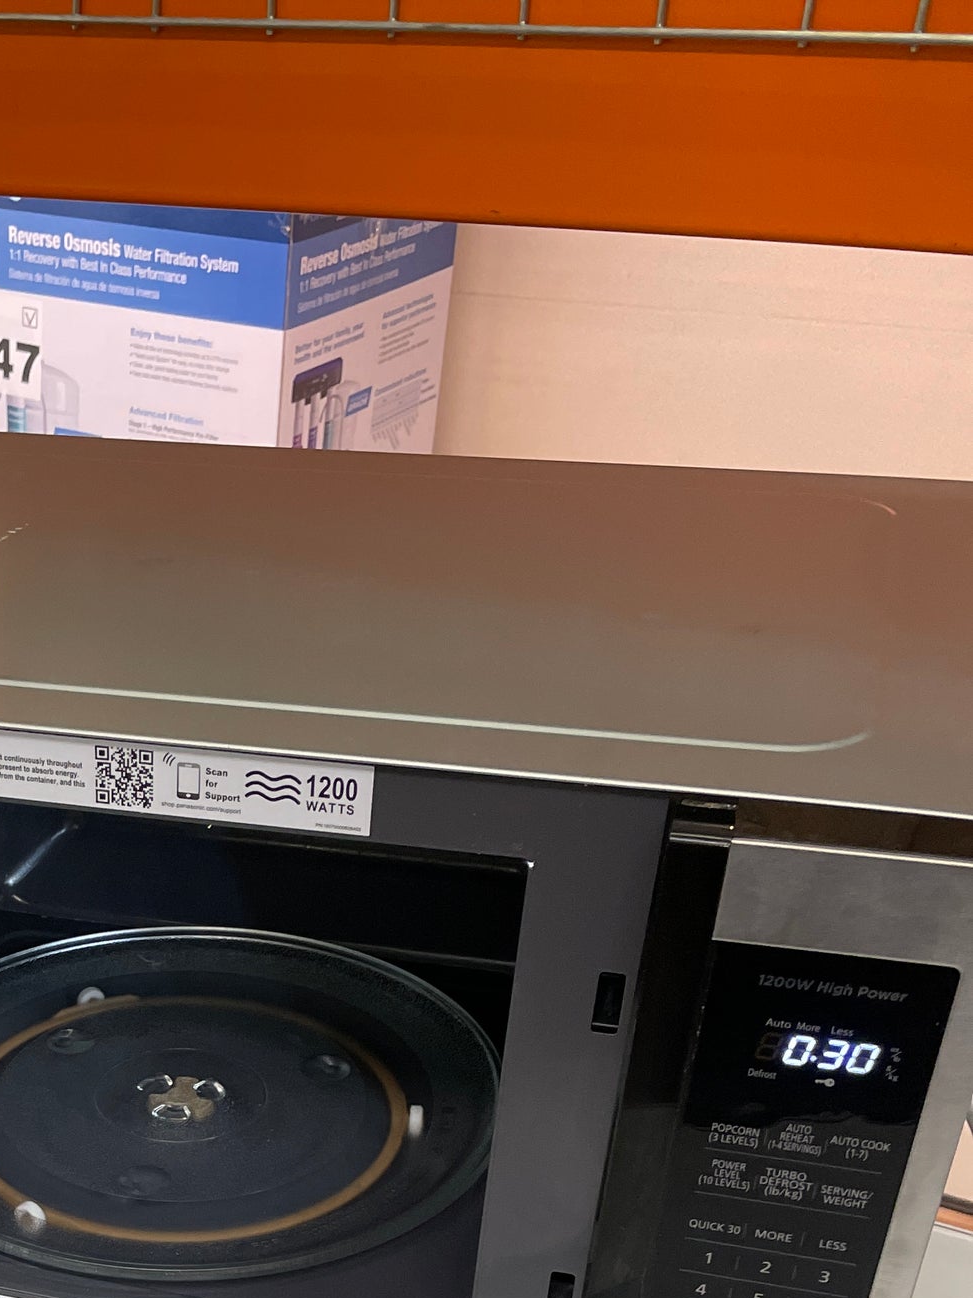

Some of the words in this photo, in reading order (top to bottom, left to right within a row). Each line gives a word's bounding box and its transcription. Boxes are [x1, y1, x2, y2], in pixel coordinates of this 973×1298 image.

[8, 225, 61, 250] Reverse
[63, 234, 122, 258] Osmosis
[123, 244, 153, 262] Water
[154, 247, 199, 269] Filtration
[199, 253, 240, 274] System
[205, 768, 228, 777] Scan
[205, 780, 217, 789] for
[307, 775, 358, 801] 1200
[205, 792, 240, 803] Support
[306, 801, 355, 815] WATTS
[758, 974, 815, 991] 1200W
[816, 980, 854, 997] High
[857, 985, 909, 1003] Power
[765, 1018, 791, 1030] Auto
[796, 1022, 821, 1032] More
[831, 1026, 854, 1037] Less
[747, 1068, 776, 1080] Defrost
[711, 1123, 761, 1137] POPCORN
[786, 1124, 812, 1134] AUTO
[708, 1132, 719, 1143] (3
[720, 1134, 759, 1150] LEVELS)
[779, 1132, 815, 1143] REHEAT
[829, 1135, 860, 1149] AUTO
[860, 1139, 892, 1153] COOK
[712, 1159, 746, 1172] POWER
[714, 1167, 741, 1180] LEVEL
[766, 1167, 807, 1181] TURBO
[697, 1174, 714, 1186] (10
[714, 1177, 751, 1192] LEVELS)
[760, 1176, 814, 1192] DEFROST
[764, 1185, 802, 1201] (lb/kg)
[821, 1185, 874, 1200] SERVING/
[823, 1196, 867, 1209] WEIGHT
[688, 1218, 726, 1232] QUICK
[727, 1224, 742, 1235] 30
[755, 1230, 793, 1243] MORE
[819, 1240, 847, 1251] LESS
[705, 1252, 713, 1264] 1
[760, 1262, 771, 1274] 2
[819, 1271, 831, 1283] 3
[695, 1284, 707, 1295] 4
